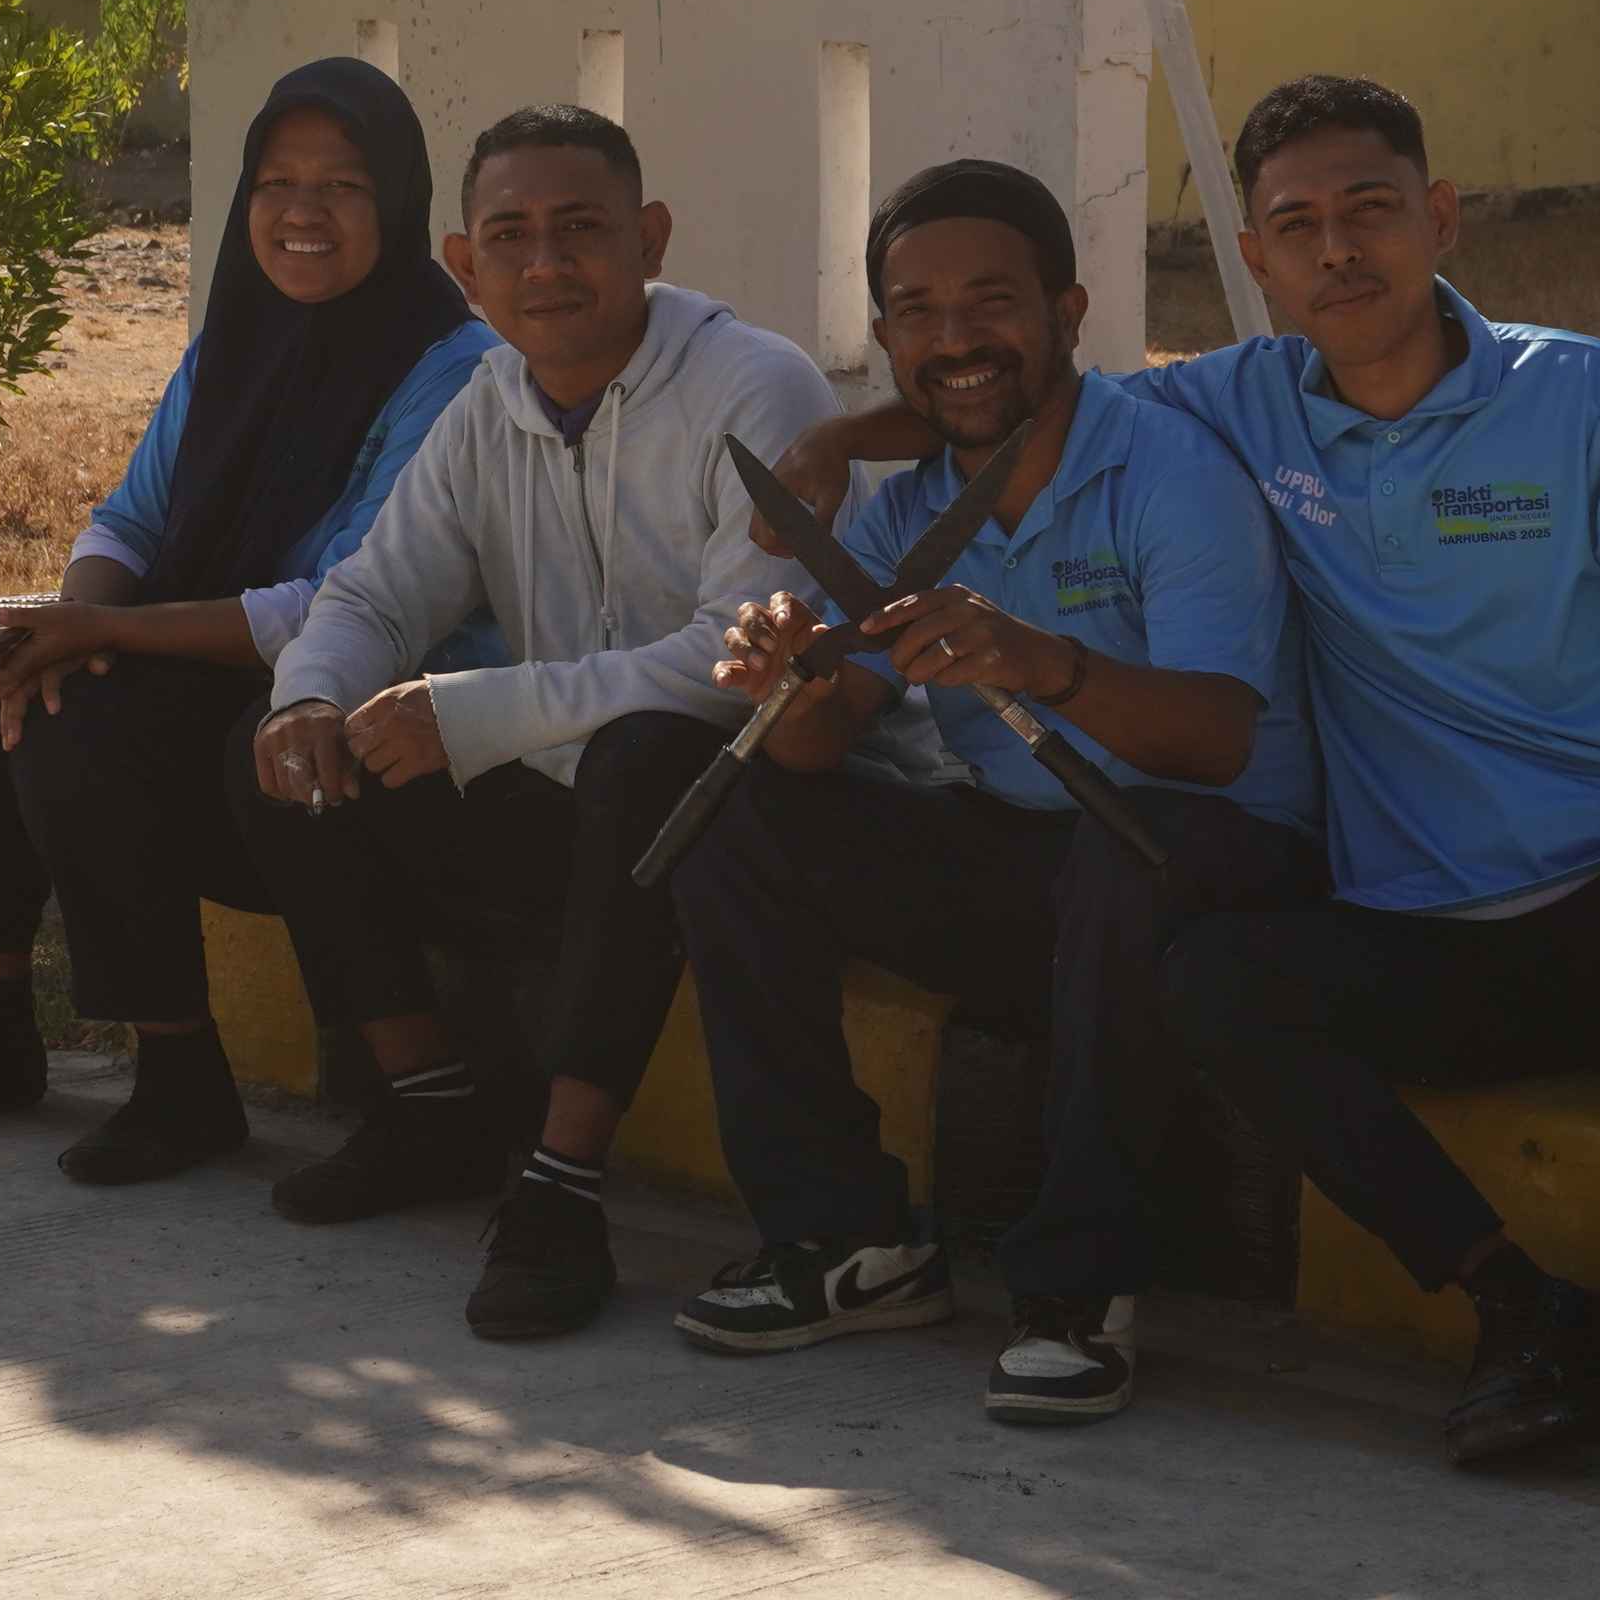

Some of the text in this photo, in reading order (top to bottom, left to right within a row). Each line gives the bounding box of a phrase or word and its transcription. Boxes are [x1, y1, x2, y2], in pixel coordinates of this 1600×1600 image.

[1275, 465, 1325, 498] UPBU
[1443, 483, 1491, 504] Bakti
[1297, 500, 1337, 527] Alor
[1432, 492, 1550, 518] Transportasi
[1438, 528, 1552, 546] HARHUBNAS 2025
